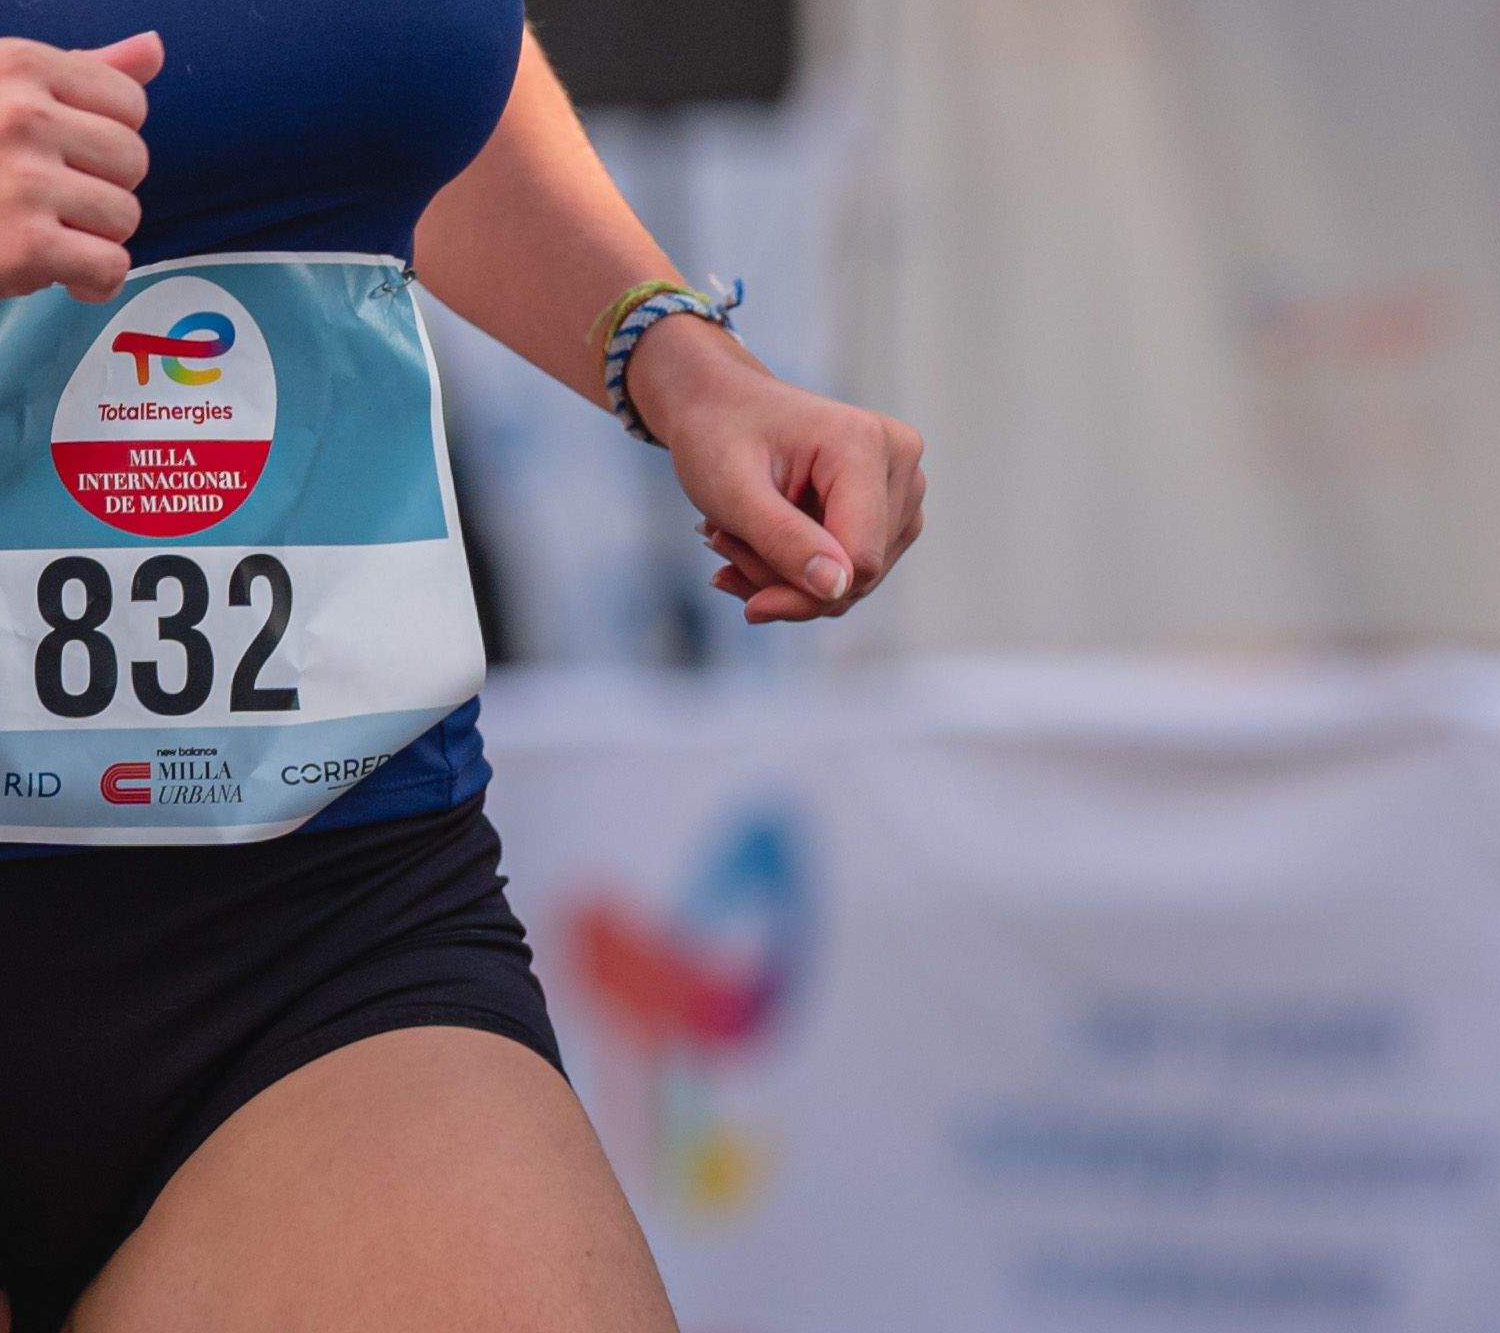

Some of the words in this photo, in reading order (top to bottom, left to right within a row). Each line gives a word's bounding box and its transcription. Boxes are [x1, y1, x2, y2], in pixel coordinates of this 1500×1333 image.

[98, 401, 233, 424] TotalEnergies
[129, 448, 198, 467] MILLA
[105, 496, 135, 514] DE
[140, 494, 224, 513] MADRID
[34, 553, 300, 718] 832
[157, 747, 177, 758] new
[178, 746, 218, 757] balance
[157, 760, 232, 781] MILLA
[157, 784, 244, 806] URBANA
